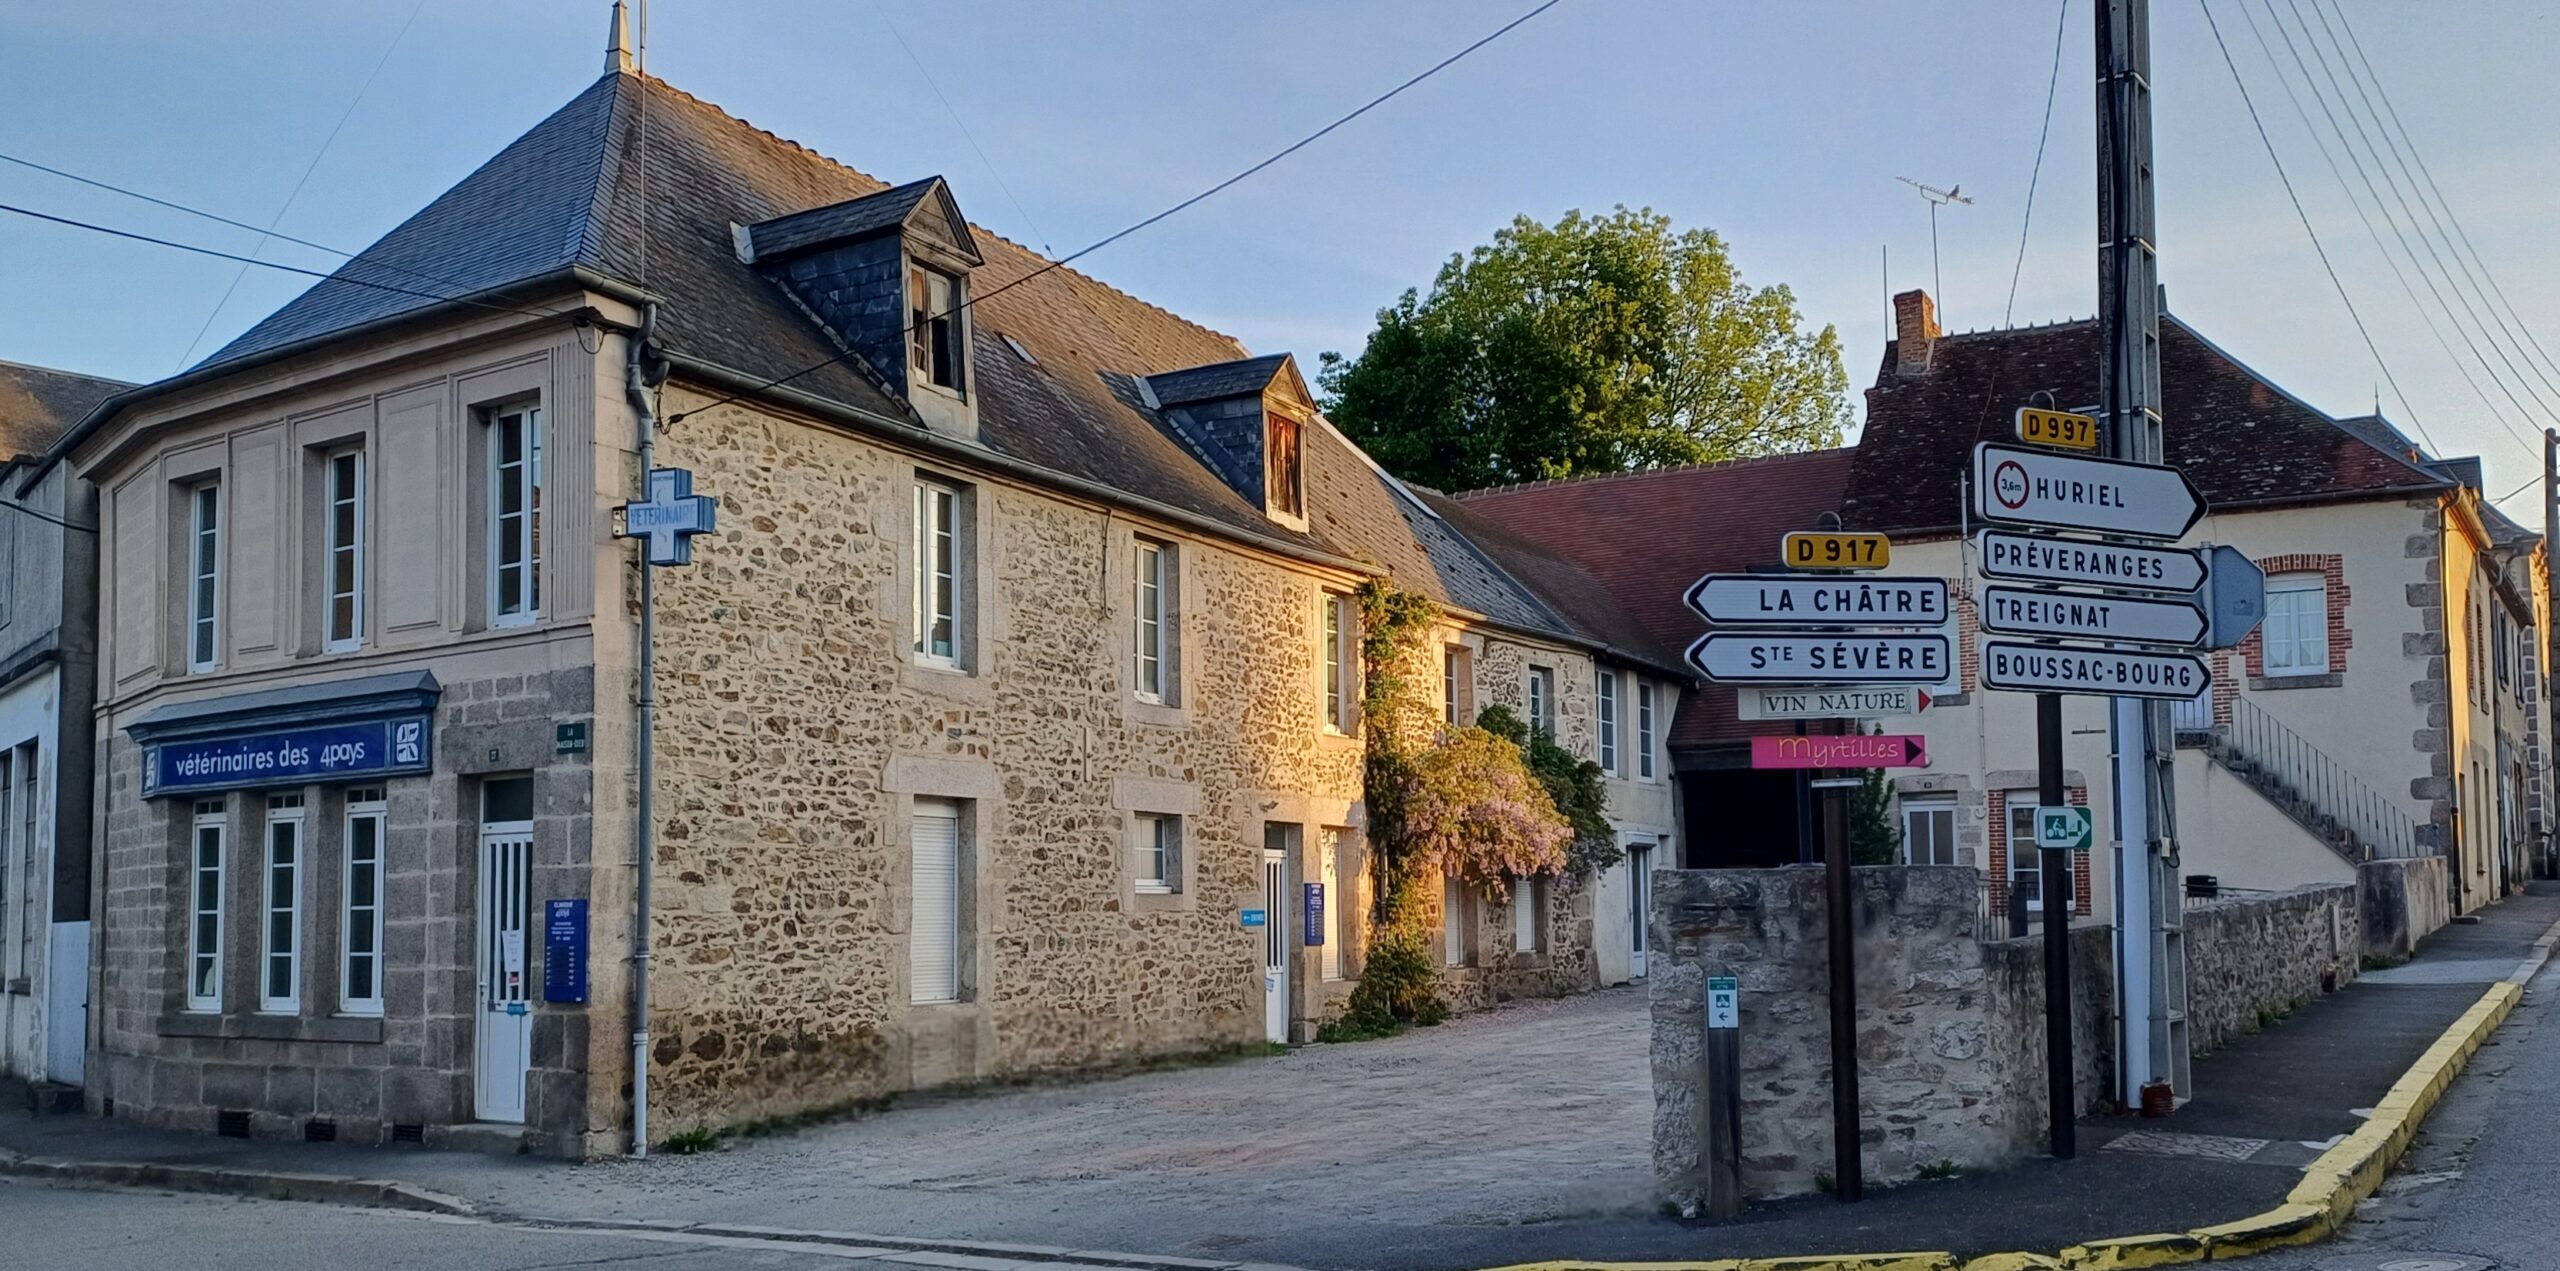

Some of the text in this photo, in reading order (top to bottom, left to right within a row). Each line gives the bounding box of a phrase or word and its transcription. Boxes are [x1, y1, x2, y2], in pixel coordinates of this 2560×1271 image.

[2028, 414, 2089, 442] D 997
[2001, 478, 2022, 492] 3,6m
[2036, 477, 2125, 508] HURIEL
[1797, 539, 1878, 562] D 917
[1993, 541, 2164, 580] PRÉVERANGES
[1760, 584, 1935, 613] LA CHÂTRE
[1996, 598, 2110, 629] TREIGNAT
[1809, 641, 1937, 670] SÉVÈRE
[1996, 653, 2192, 688] BOUSSAC-BOURG
[1766, 692, 1906, 712] VIN NATURE
[176, 740, 366, 776] vétérinaires des 4pays
[1778, 736, 1899, 769] Myrtilles
